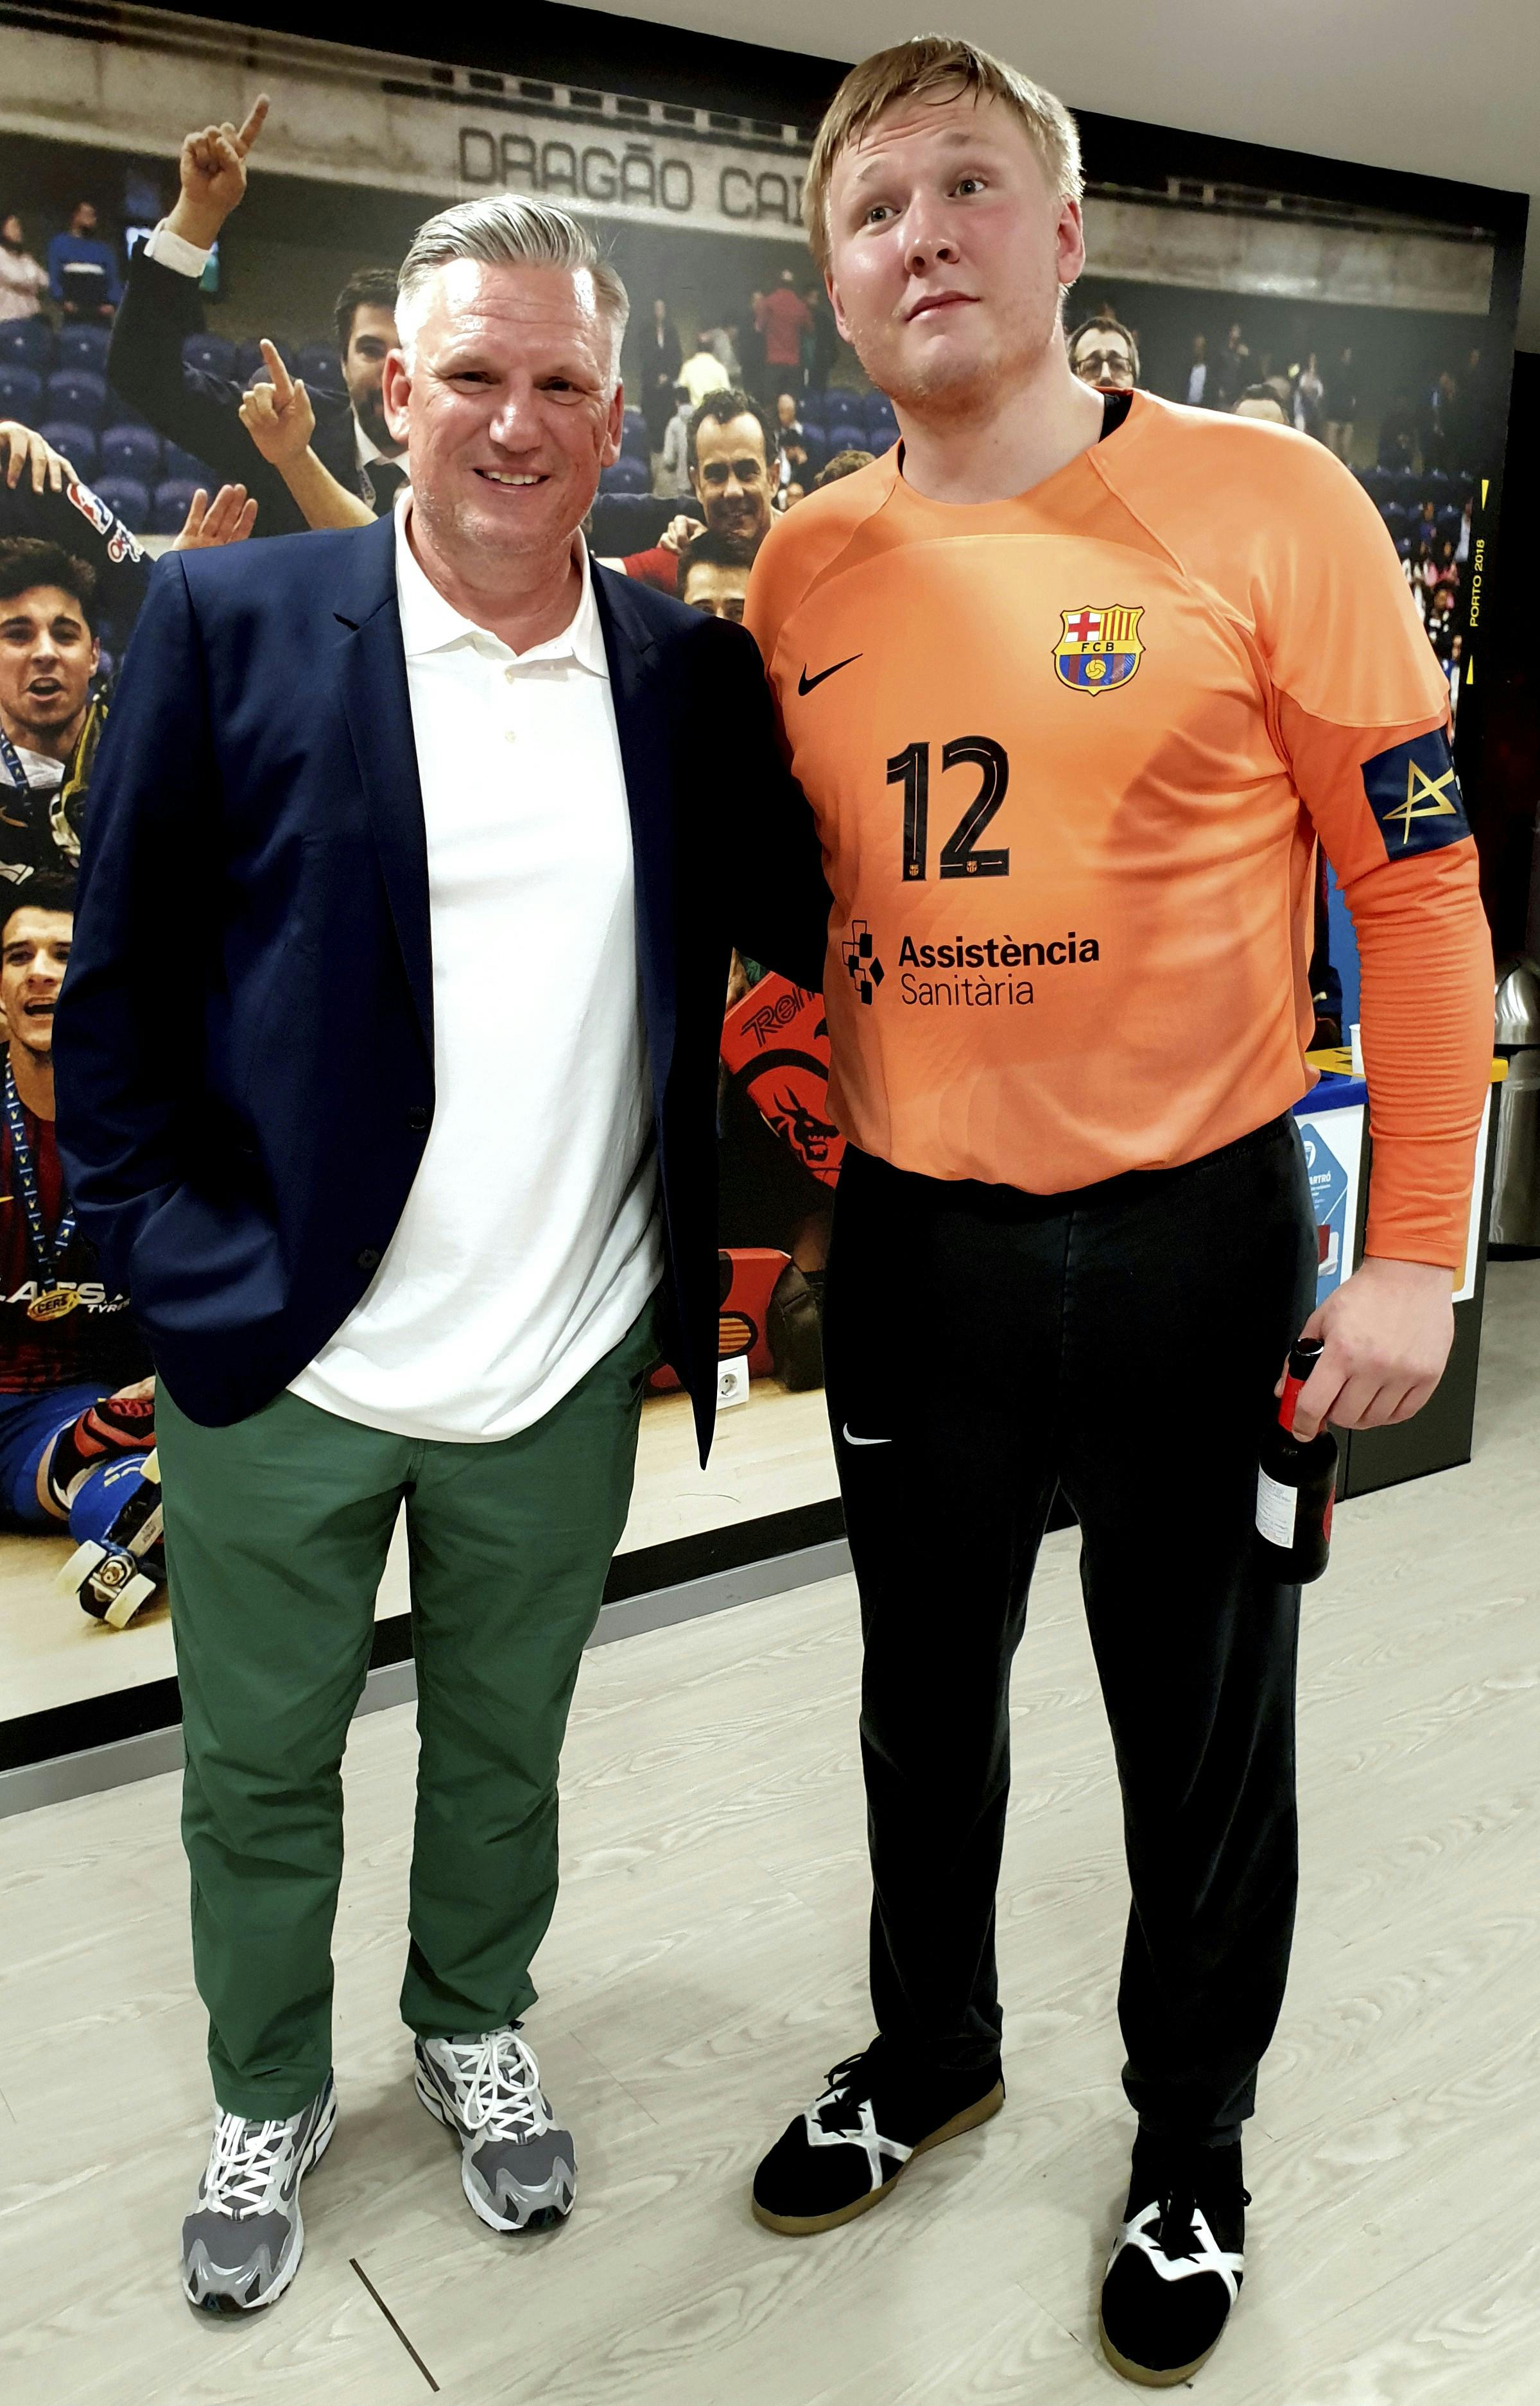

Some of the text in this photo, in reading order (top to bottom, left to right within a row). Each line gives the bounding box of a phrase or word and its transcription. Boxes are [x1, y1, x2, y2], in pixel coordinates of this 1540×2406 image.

[458, 128, 693, 212] DRAGÃO
[1470, 539, 1485, 627] PORTO 2018
[886, 735, 1010, 882] 12
[899, 931, 1100, 968] Assistència
[901, 973, 1034, 1006] Sanitària
